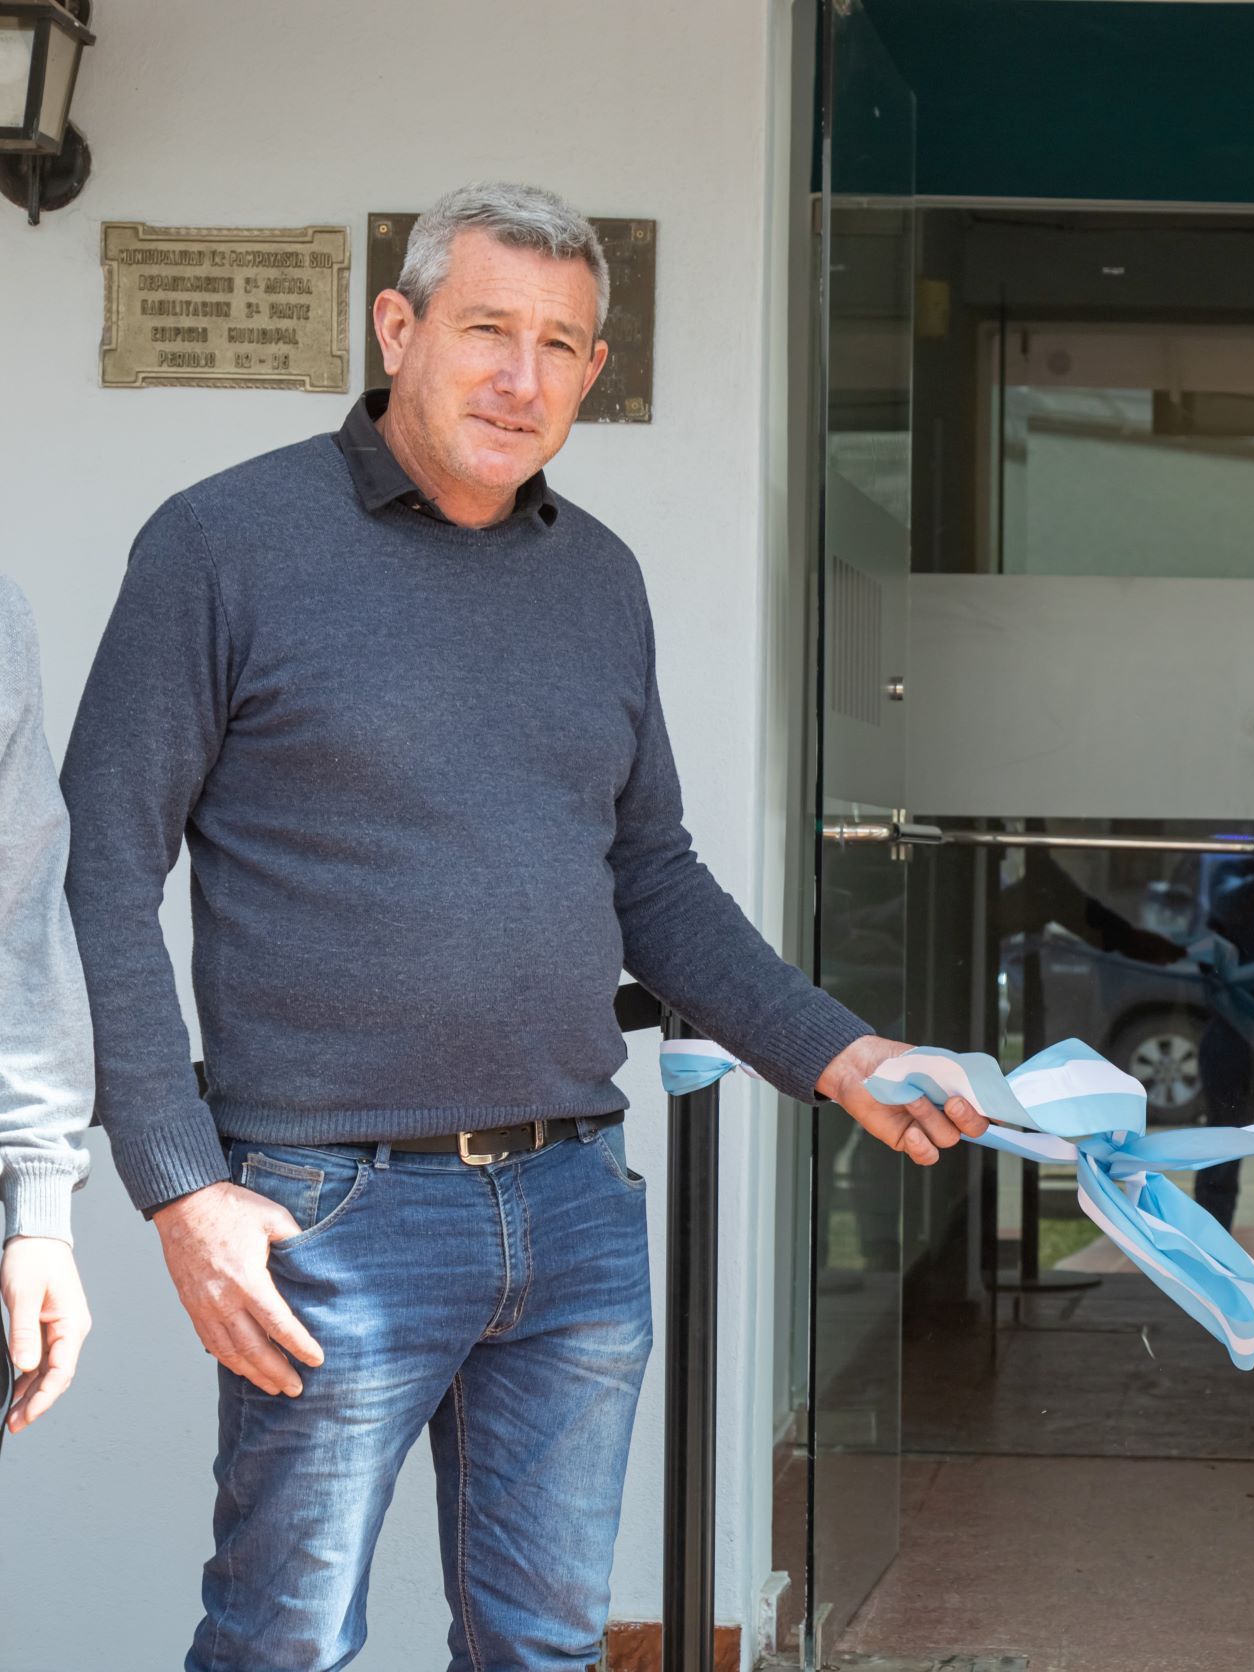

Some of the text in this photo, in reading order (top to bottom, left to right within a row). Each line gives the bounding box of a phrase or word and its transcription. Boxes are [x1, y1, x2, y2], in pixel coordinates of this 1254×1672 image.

[118, 248, 333, 269] MUNICIPALIDAD DE PAMPAYASTA SUD
[138, 274, 235, 293] DEPARTAMENTO
[264, 277, 313, 295] ARRIBA
[269, 302, 311, 320] PARTE
[227, 327, 299, 345] MUNICIPAL
[158, 349, 216, 368] PERIODO
